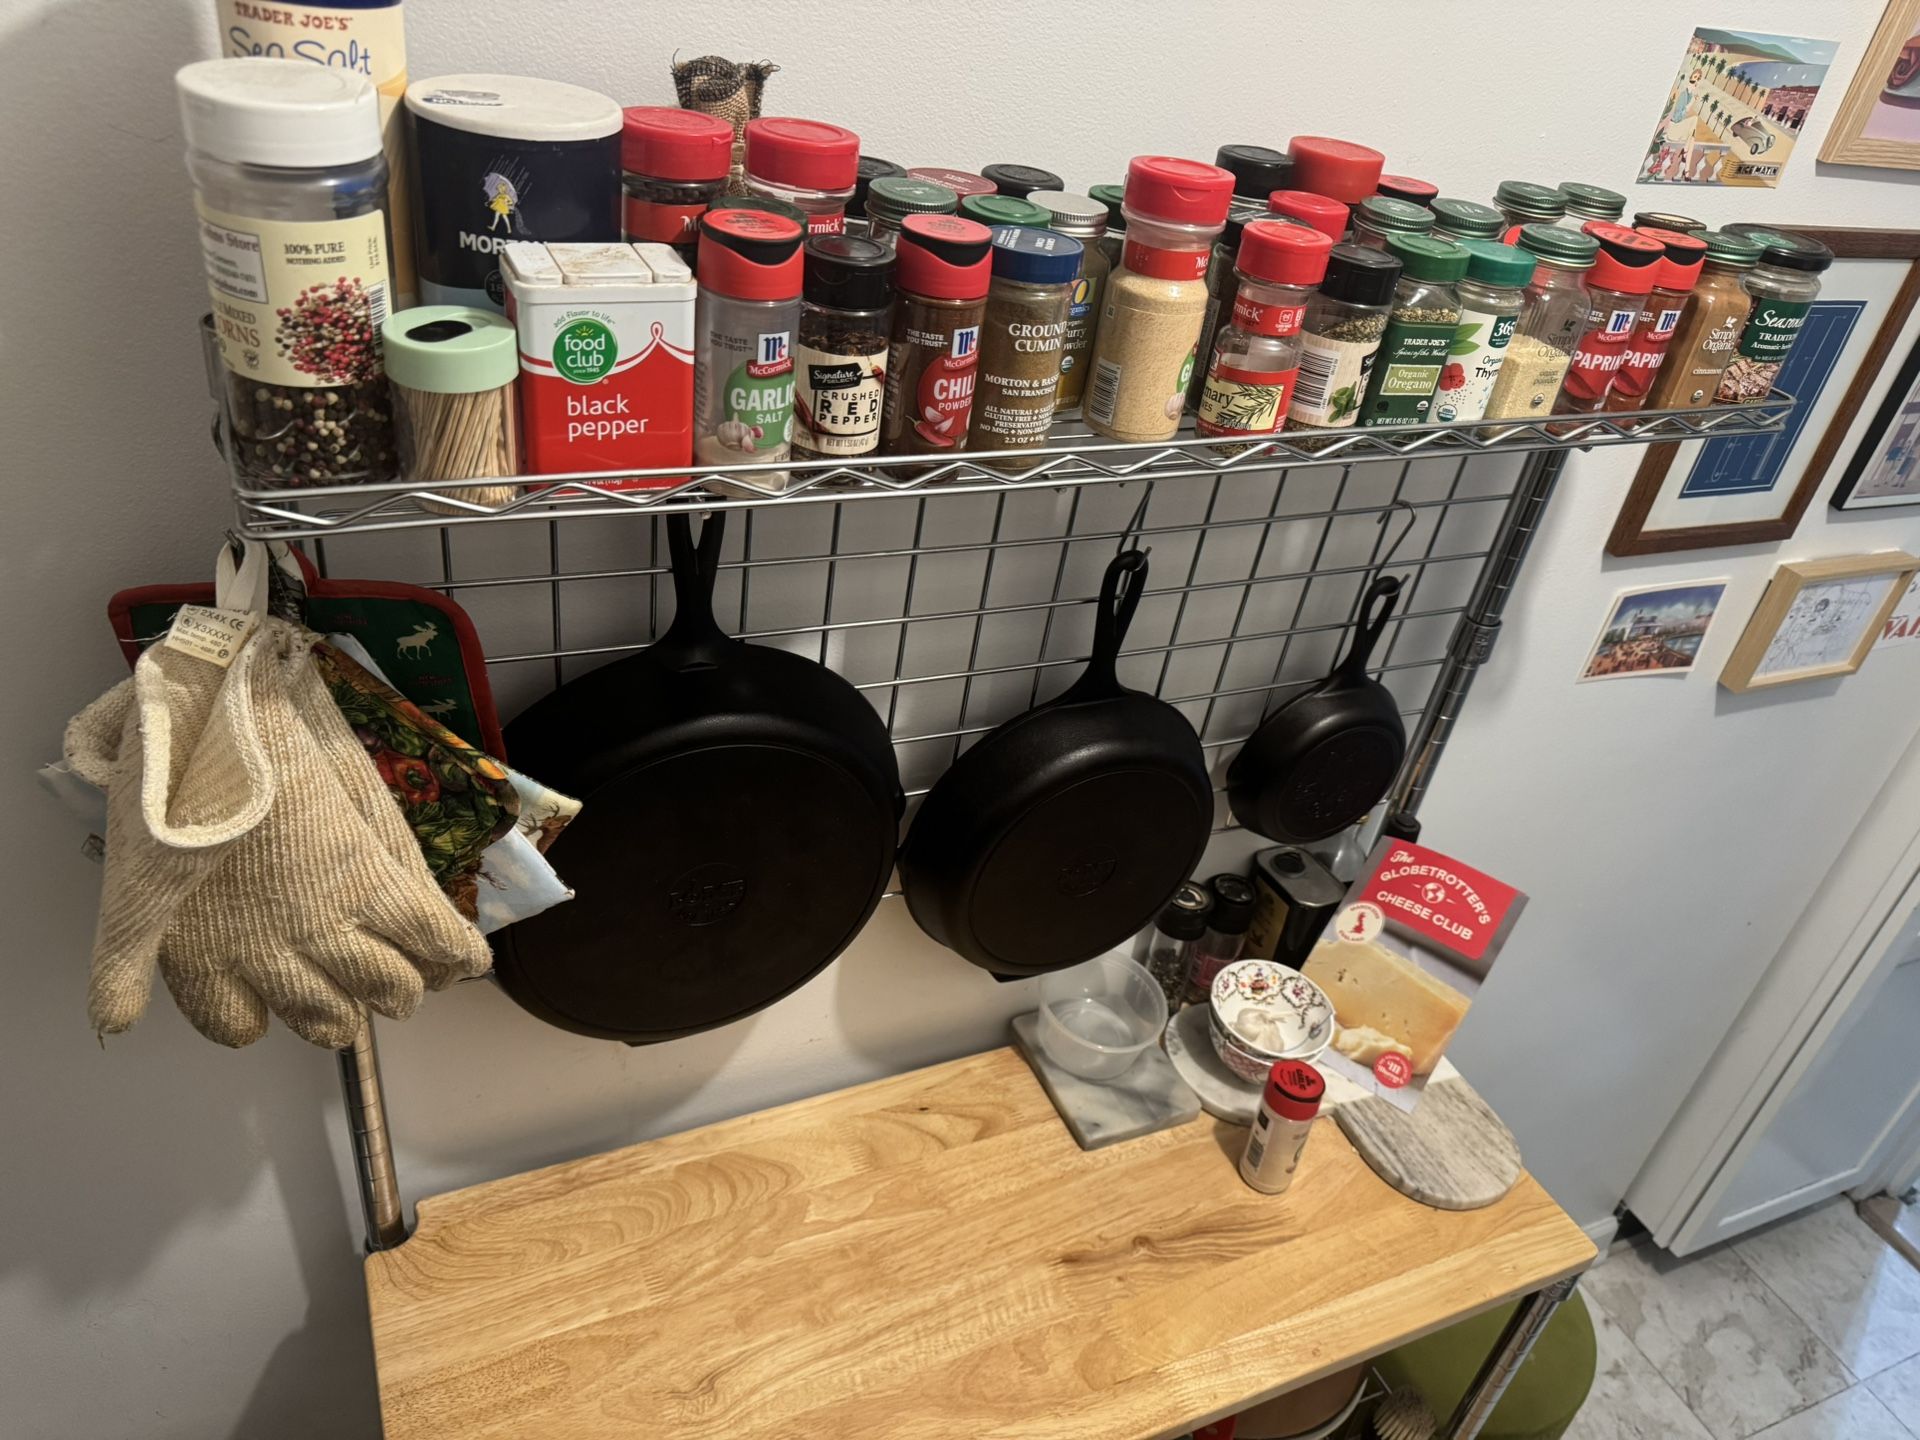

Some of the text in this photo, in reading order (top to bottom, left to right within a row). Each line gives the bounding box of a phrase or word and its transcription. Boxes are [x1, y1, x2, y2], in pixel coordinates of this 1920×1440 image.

[235, 2, 349, 30] TRADER JOE'S
[230, 26, 371, 75] Sea Salt
[284, 242, 344, 255] 100% PURE
[286, 256, 346, 265] NOTHING ADDED
[1008, 320, 1068, 337] GROUND
[1066, 328, 1086, 338] urry
[564, 333, 605, 351] food
[724, 334, 748, 346] TASTE
[921, 332, 944, 340] TASTE
[921, 340, 942, 348] TRUST
[1014, 336, 1062, 352] CUMIN
[1702, 339, 1734, 353] Organic
[1750, 342, 1780, 350] Aromatic
[566, 350, 604, 367] club
[748, 358, 792, 375] McCormick
[813, 370, 855, 383] Signature
[1398, 370, 1428, 378] Organic
[985, 374, 1030, 388] MORTON
[1388, 377, 1431, 390] Oregano
[821, 389, 879, 400] CRUSHED
[567, 393, 630, 416] black
[820, 399, 878, 415] RED
[1000, 407, 1033, 415] NATURAL
[756, 411, 784, 424] SALT
[819, 412, 876, 424] PEPPER
[984, 412, 1012, 421] GLUTEN
[568, 419, 649, 442] pepper
[992, 426, 1009, 434] MSG
[200, 609, 228, 624] 2X4X
[193, 622, 233, 642] X3XXXX
[1390, 850, 1415, 863] The
[1380, 865, 1491, 924] GLOBETROTTER'S
[1377, 891, 1433, 920] CHEESE
[1432, 914, 1473, 940] CLUB
